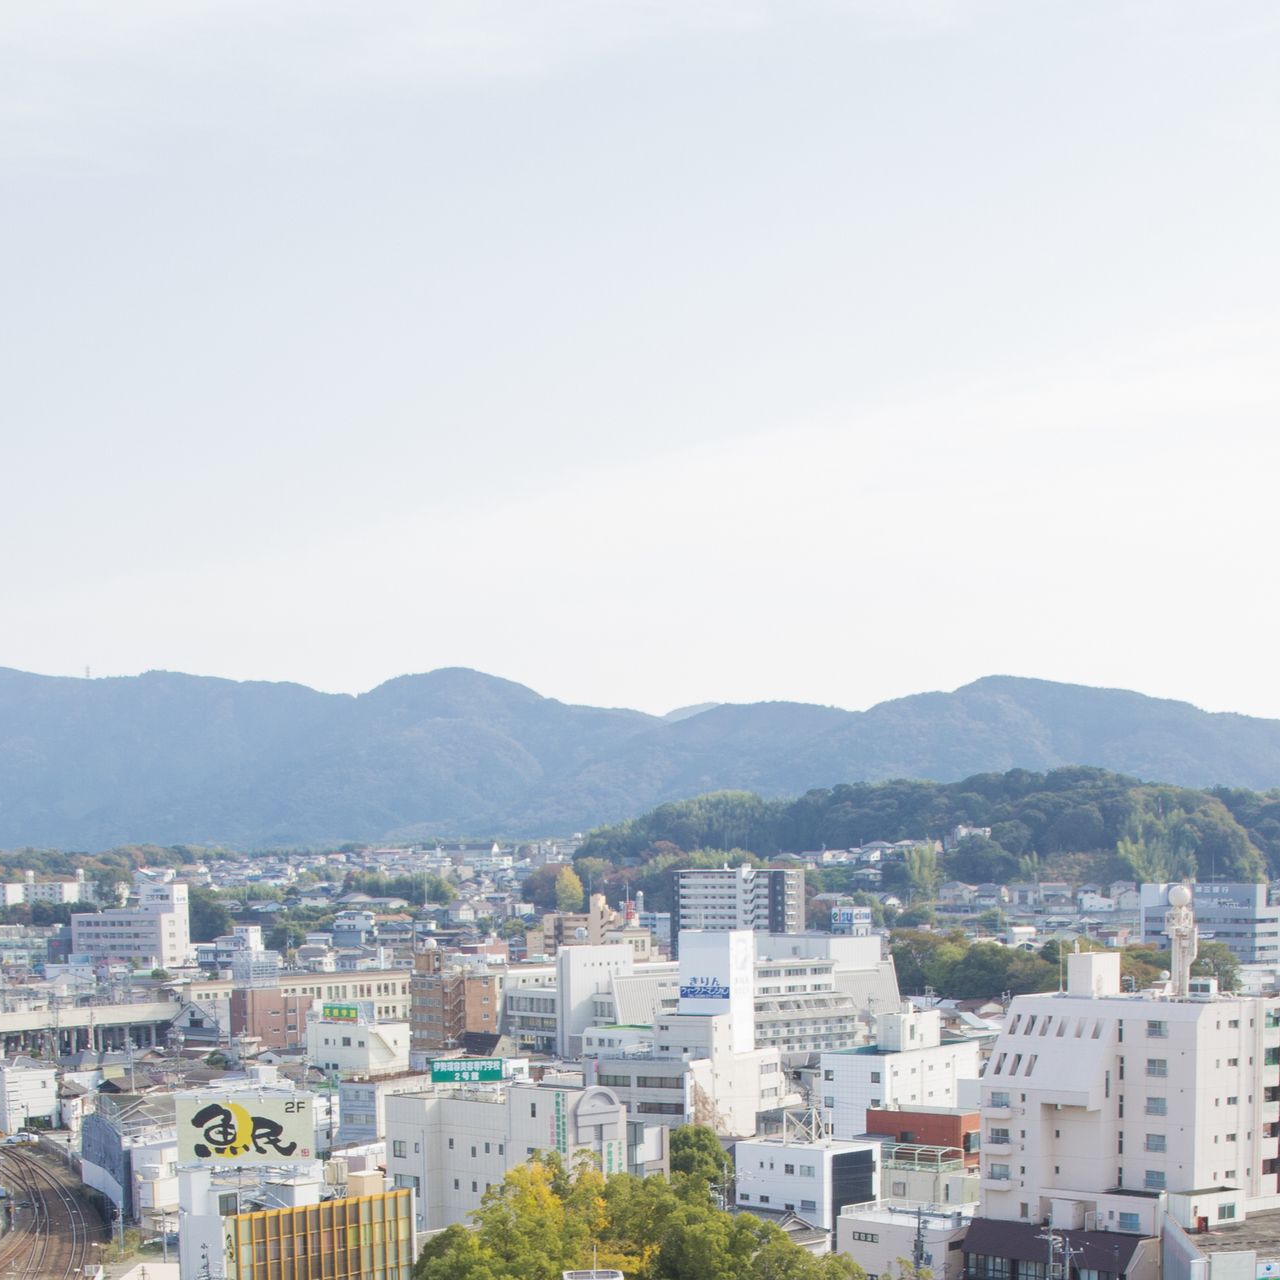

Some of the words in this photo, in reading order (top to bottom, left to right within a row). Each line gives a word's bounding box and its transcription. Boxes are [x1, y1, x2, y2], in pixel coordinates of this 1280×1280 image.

[689, 977, 720, 986] きりん
[285, 1102, 305, 1113] 2F
[191, 1104, 297, 1158] 魚民
